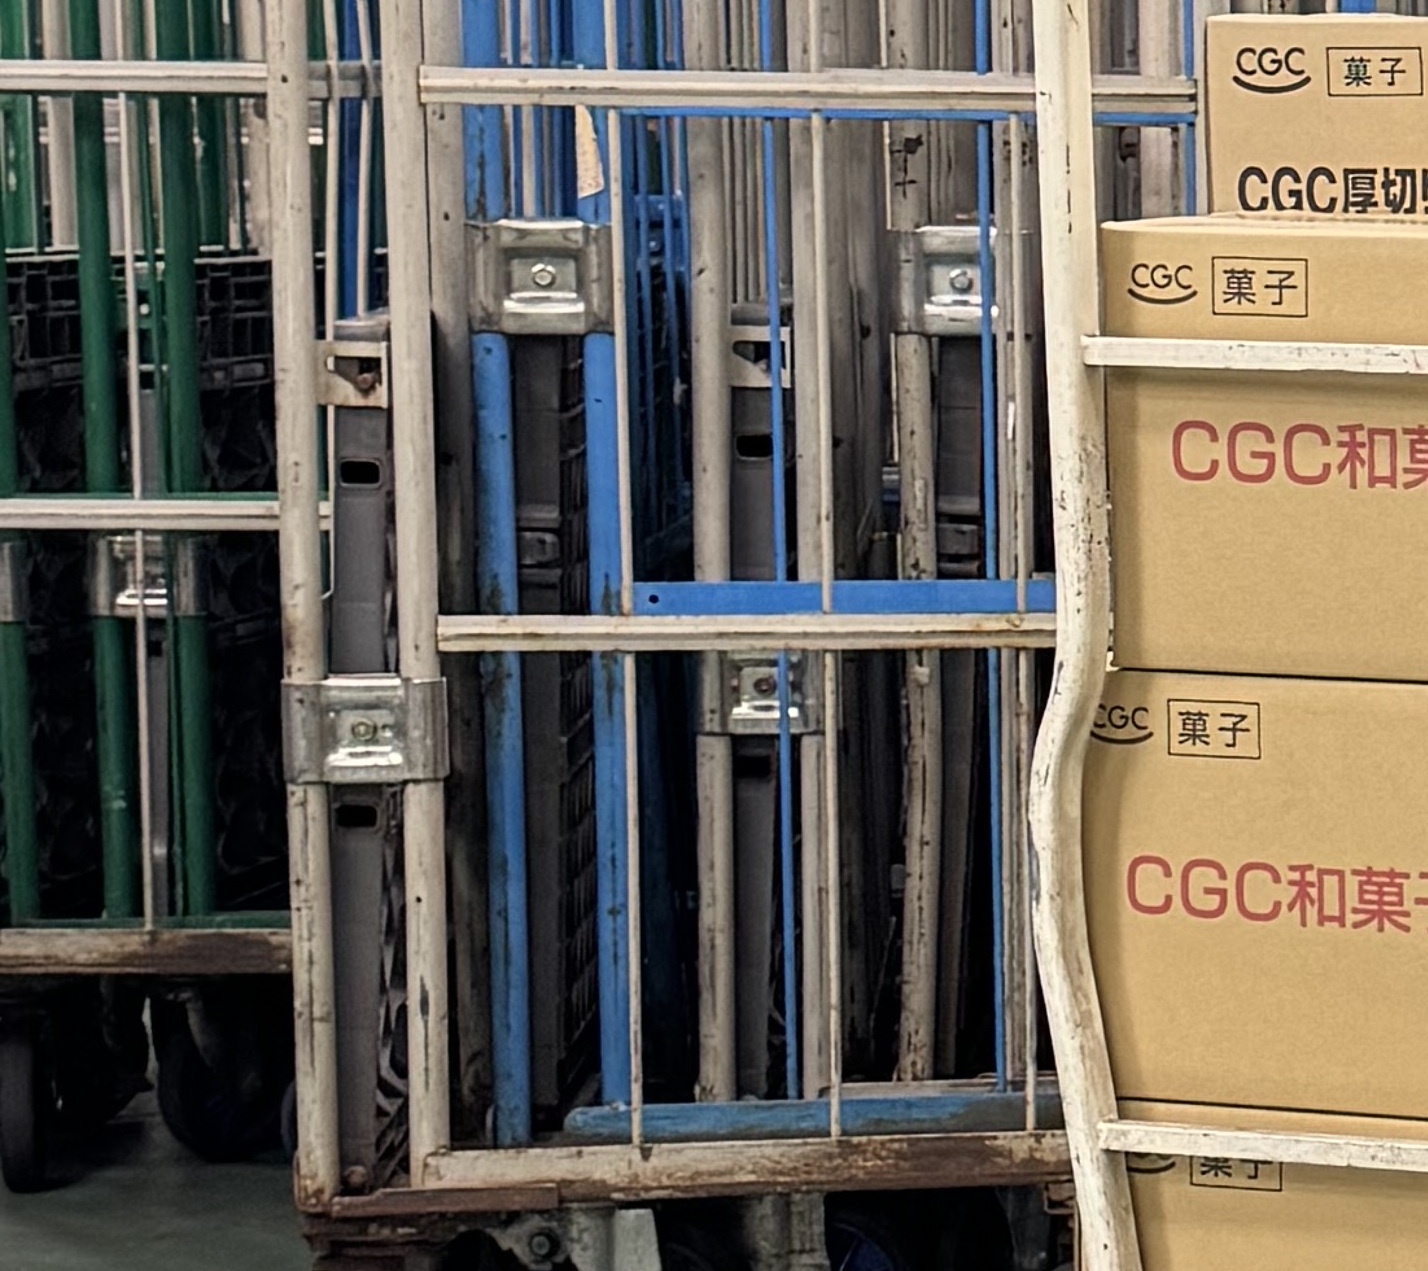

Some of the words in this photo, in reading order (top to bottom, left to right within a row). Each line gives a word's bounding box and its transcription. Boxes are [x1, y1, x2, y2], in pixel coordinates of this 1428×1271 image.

[1235, 46, 1306, 77] CGC
[1343, 56, 1407, 88] 菓子
[1130, 263, 1195, 291] CGC
[1222, 268, 1298, 307] 菓子
[1177, 711, 1252, 749] 菓子
